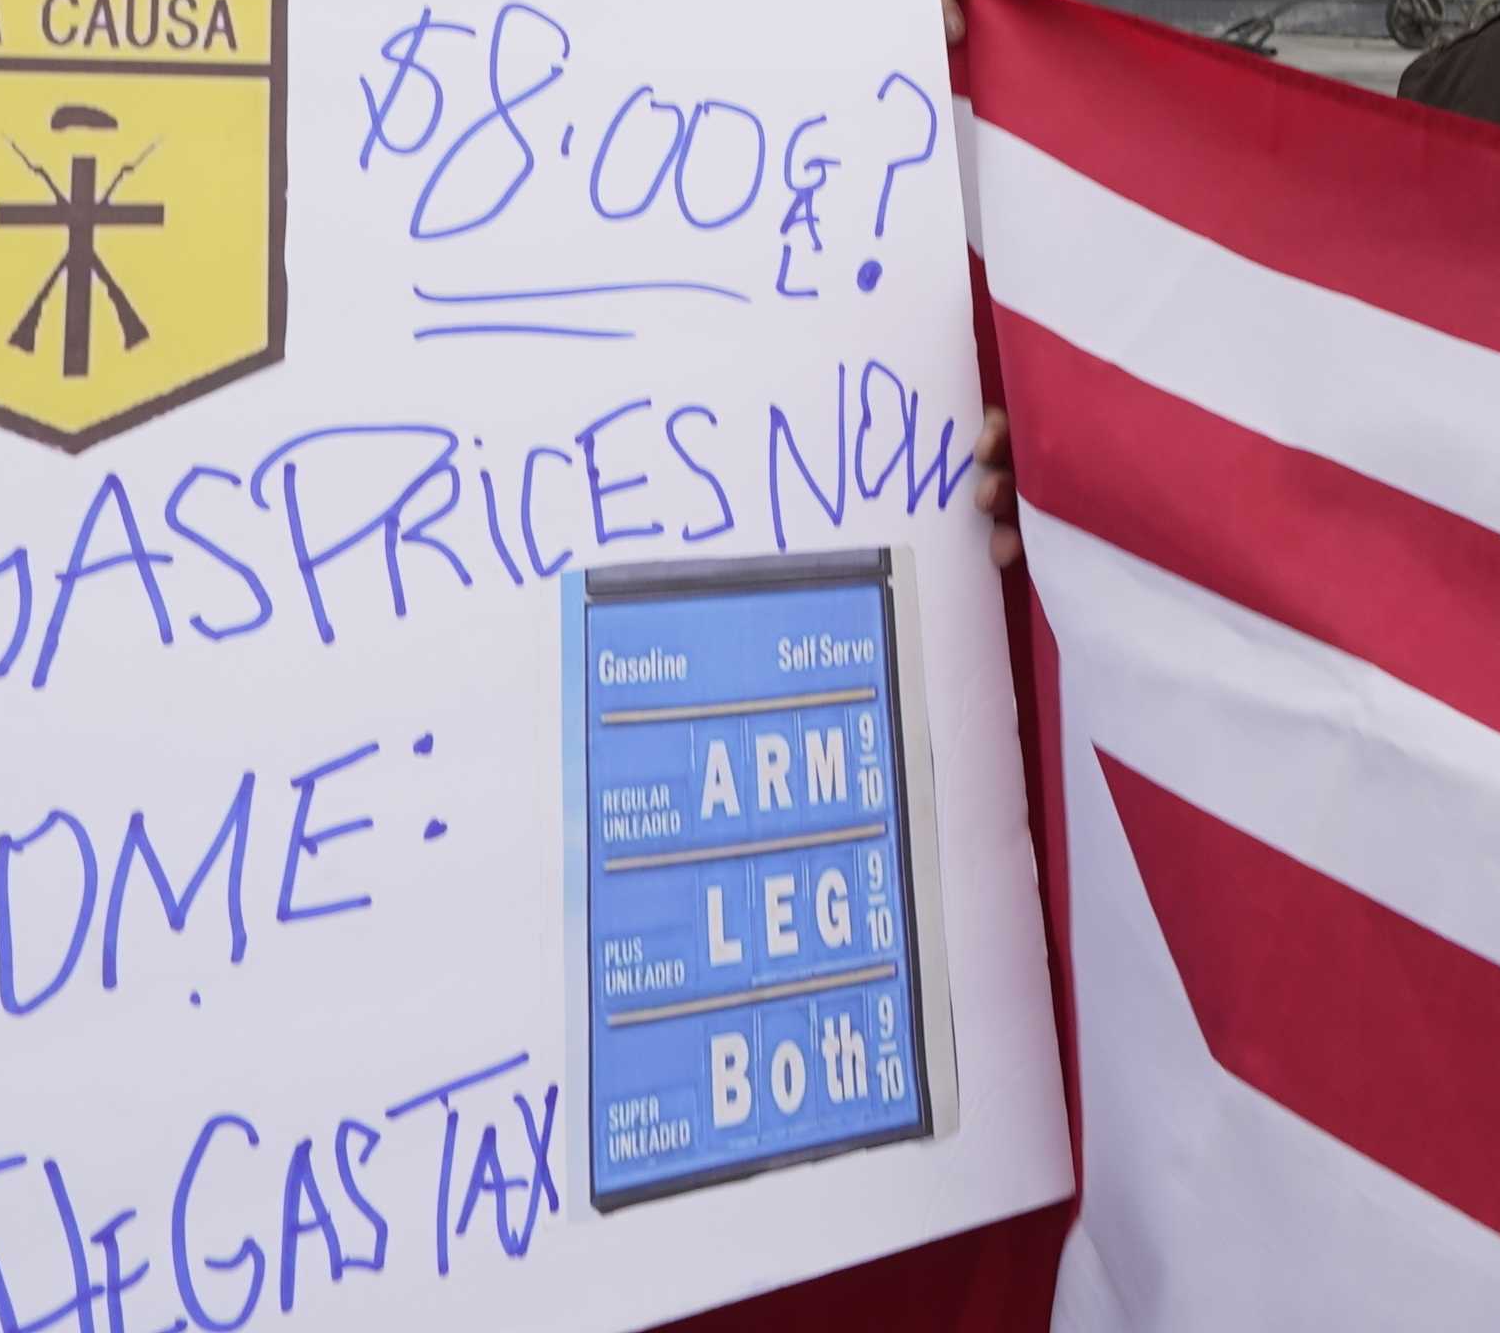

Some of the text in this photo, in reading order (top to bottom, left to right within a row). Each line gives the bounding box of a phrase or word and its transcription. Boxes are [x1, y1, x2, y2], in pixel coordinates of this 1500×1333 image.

[359, 3, 766, 240] $8.00
[770, 357, 977, 551] NOW
[598, 638, 876, 685] Gasoline Self Serve
[700, 726, 848, 821] ARM
[602, 784, 670, 815] REGULAR
[603, 810, 682, 842] UNLEADED
[706, 866, 854, 968] LEG
[604, 937, 644, 967] PLUS
[605, 960, 686, 995] UNLEADED
[710, 1013, 870, 1130] Both
[607, 1094, 661, 1131] SUPER
[608, 1119, 692, 1165] UNLEADED
